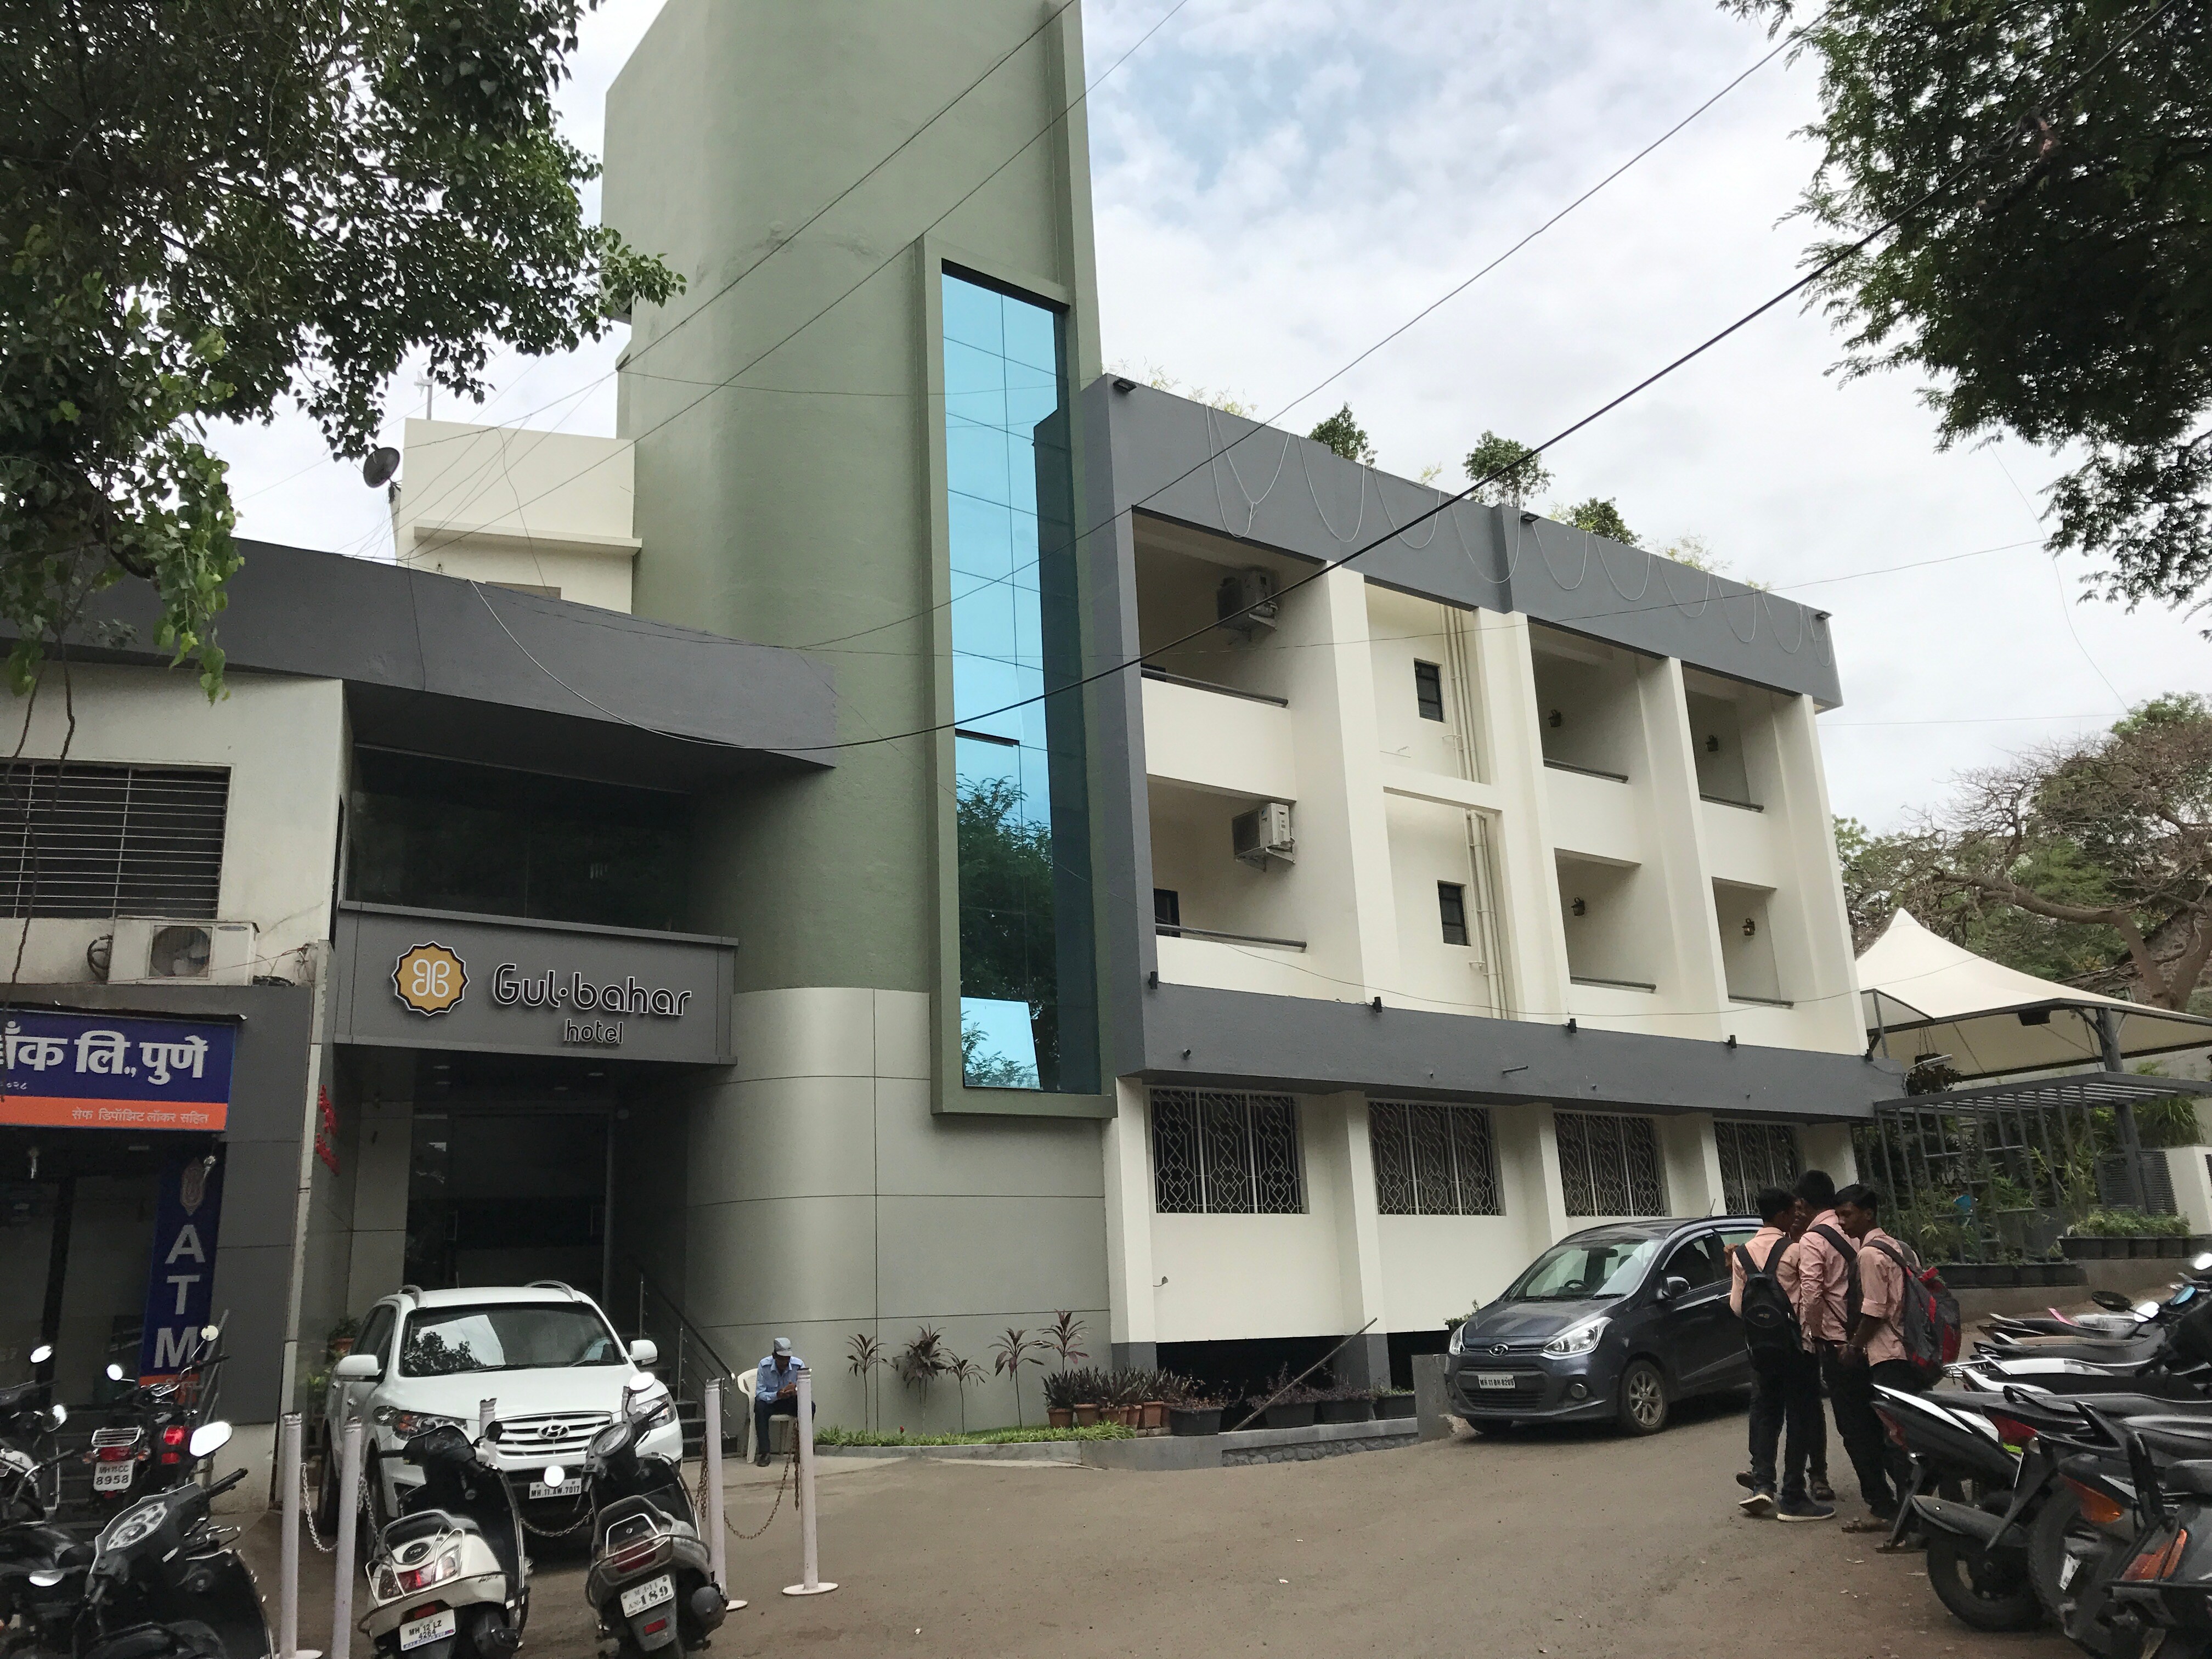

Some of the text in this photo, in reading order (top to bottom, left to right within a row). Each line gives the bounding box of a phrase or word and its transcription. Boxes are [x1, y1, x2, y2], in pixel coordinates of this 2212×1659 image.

[564, 1018, 624, 1043] hotel
[139, 1035, 208, 1085] पुणे
[72, 1107, 209, 1124] सेफ डिपॉझिट लॉकर सहित
[153, 1224, 205, 1368] ATM
[95, 1474, 129, 1486] 8958
[409, 1627, 420, 1635] MH
[433, 1620, 442, 1629] LZ
